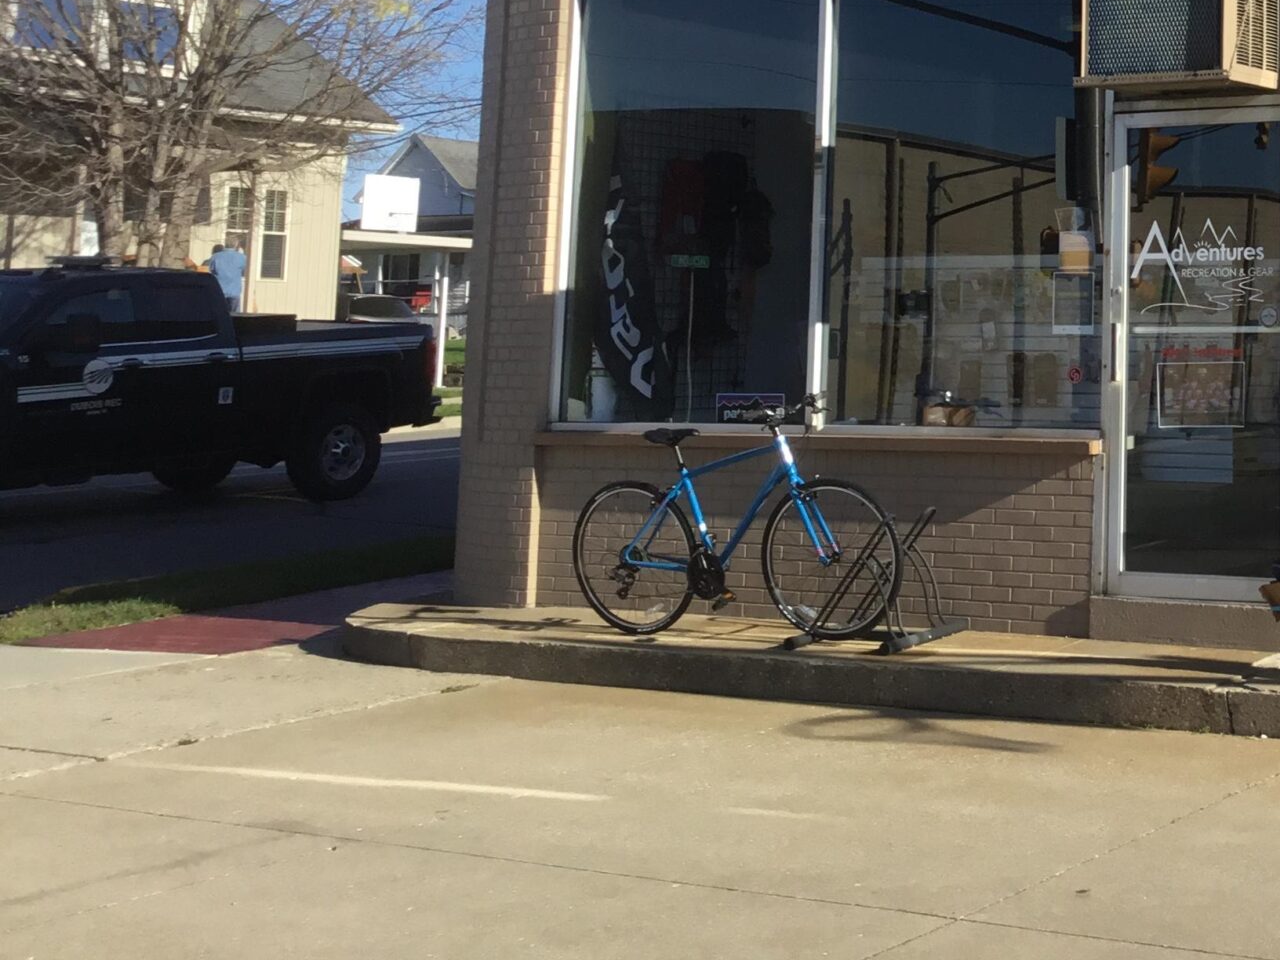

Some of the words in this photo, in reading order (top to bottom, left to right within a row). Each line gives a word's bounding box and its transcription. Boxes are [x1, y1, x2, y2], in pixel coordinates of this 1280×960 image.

[1181, 268, 1237, 278] RECREATION
[1239, 268, 1246, 277] &
[1248, 267, 1274, 277] GEAR
